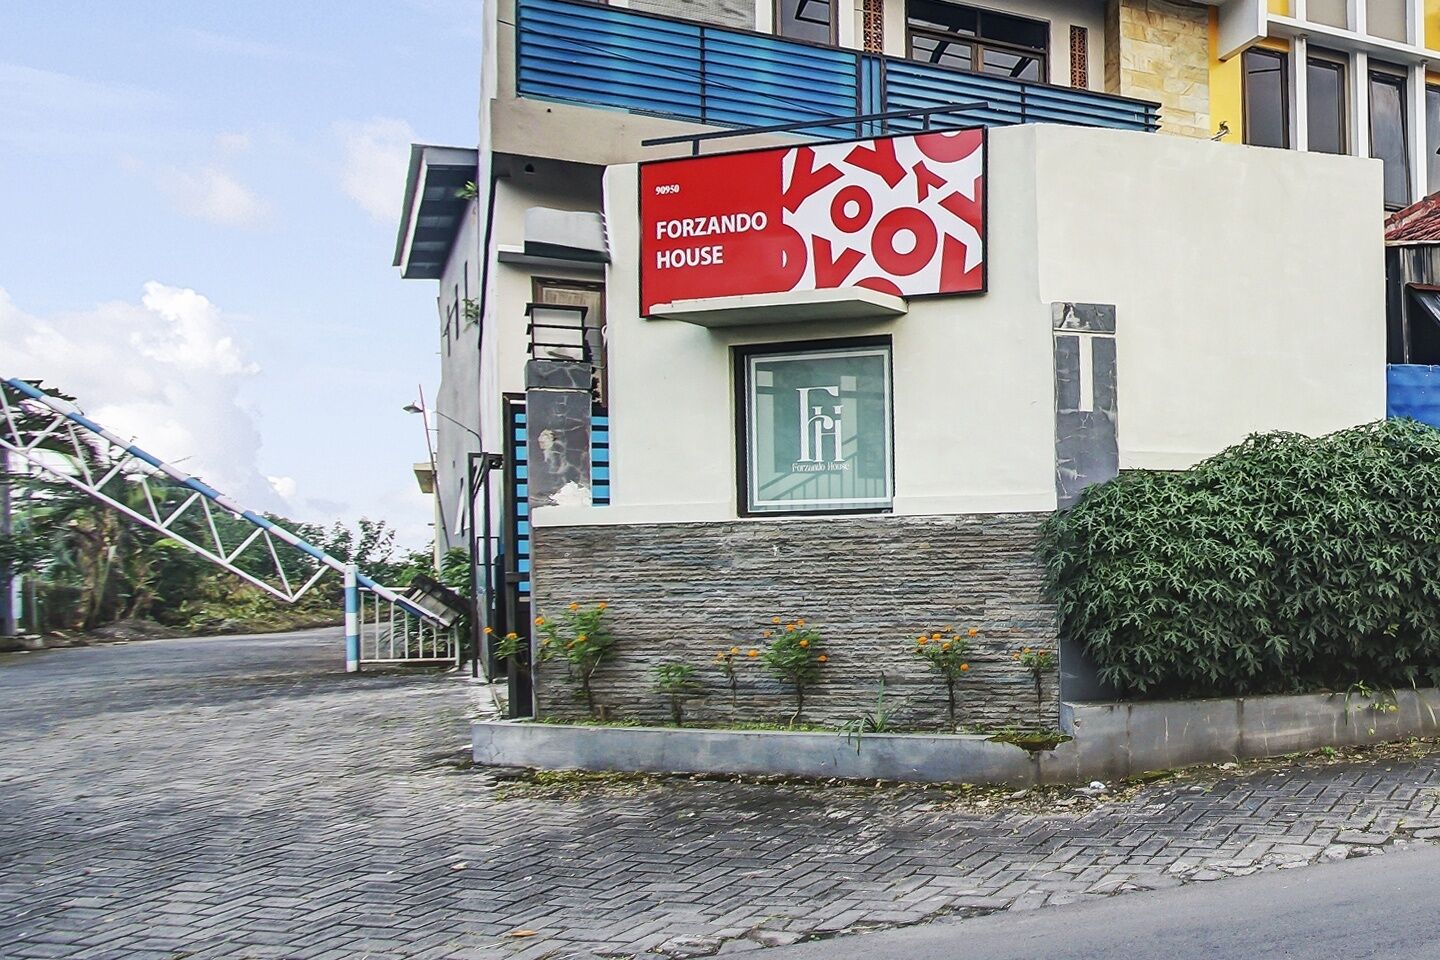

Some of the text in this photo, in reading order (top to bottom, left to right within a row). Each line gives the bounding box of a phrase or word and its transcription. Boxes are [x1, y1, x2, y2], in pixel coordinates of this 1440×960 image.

[655, 184, 680, 196] 90950
[656, 211, 768, 240] FORZANDO
[656, 245, 724, 269] HOUSE
